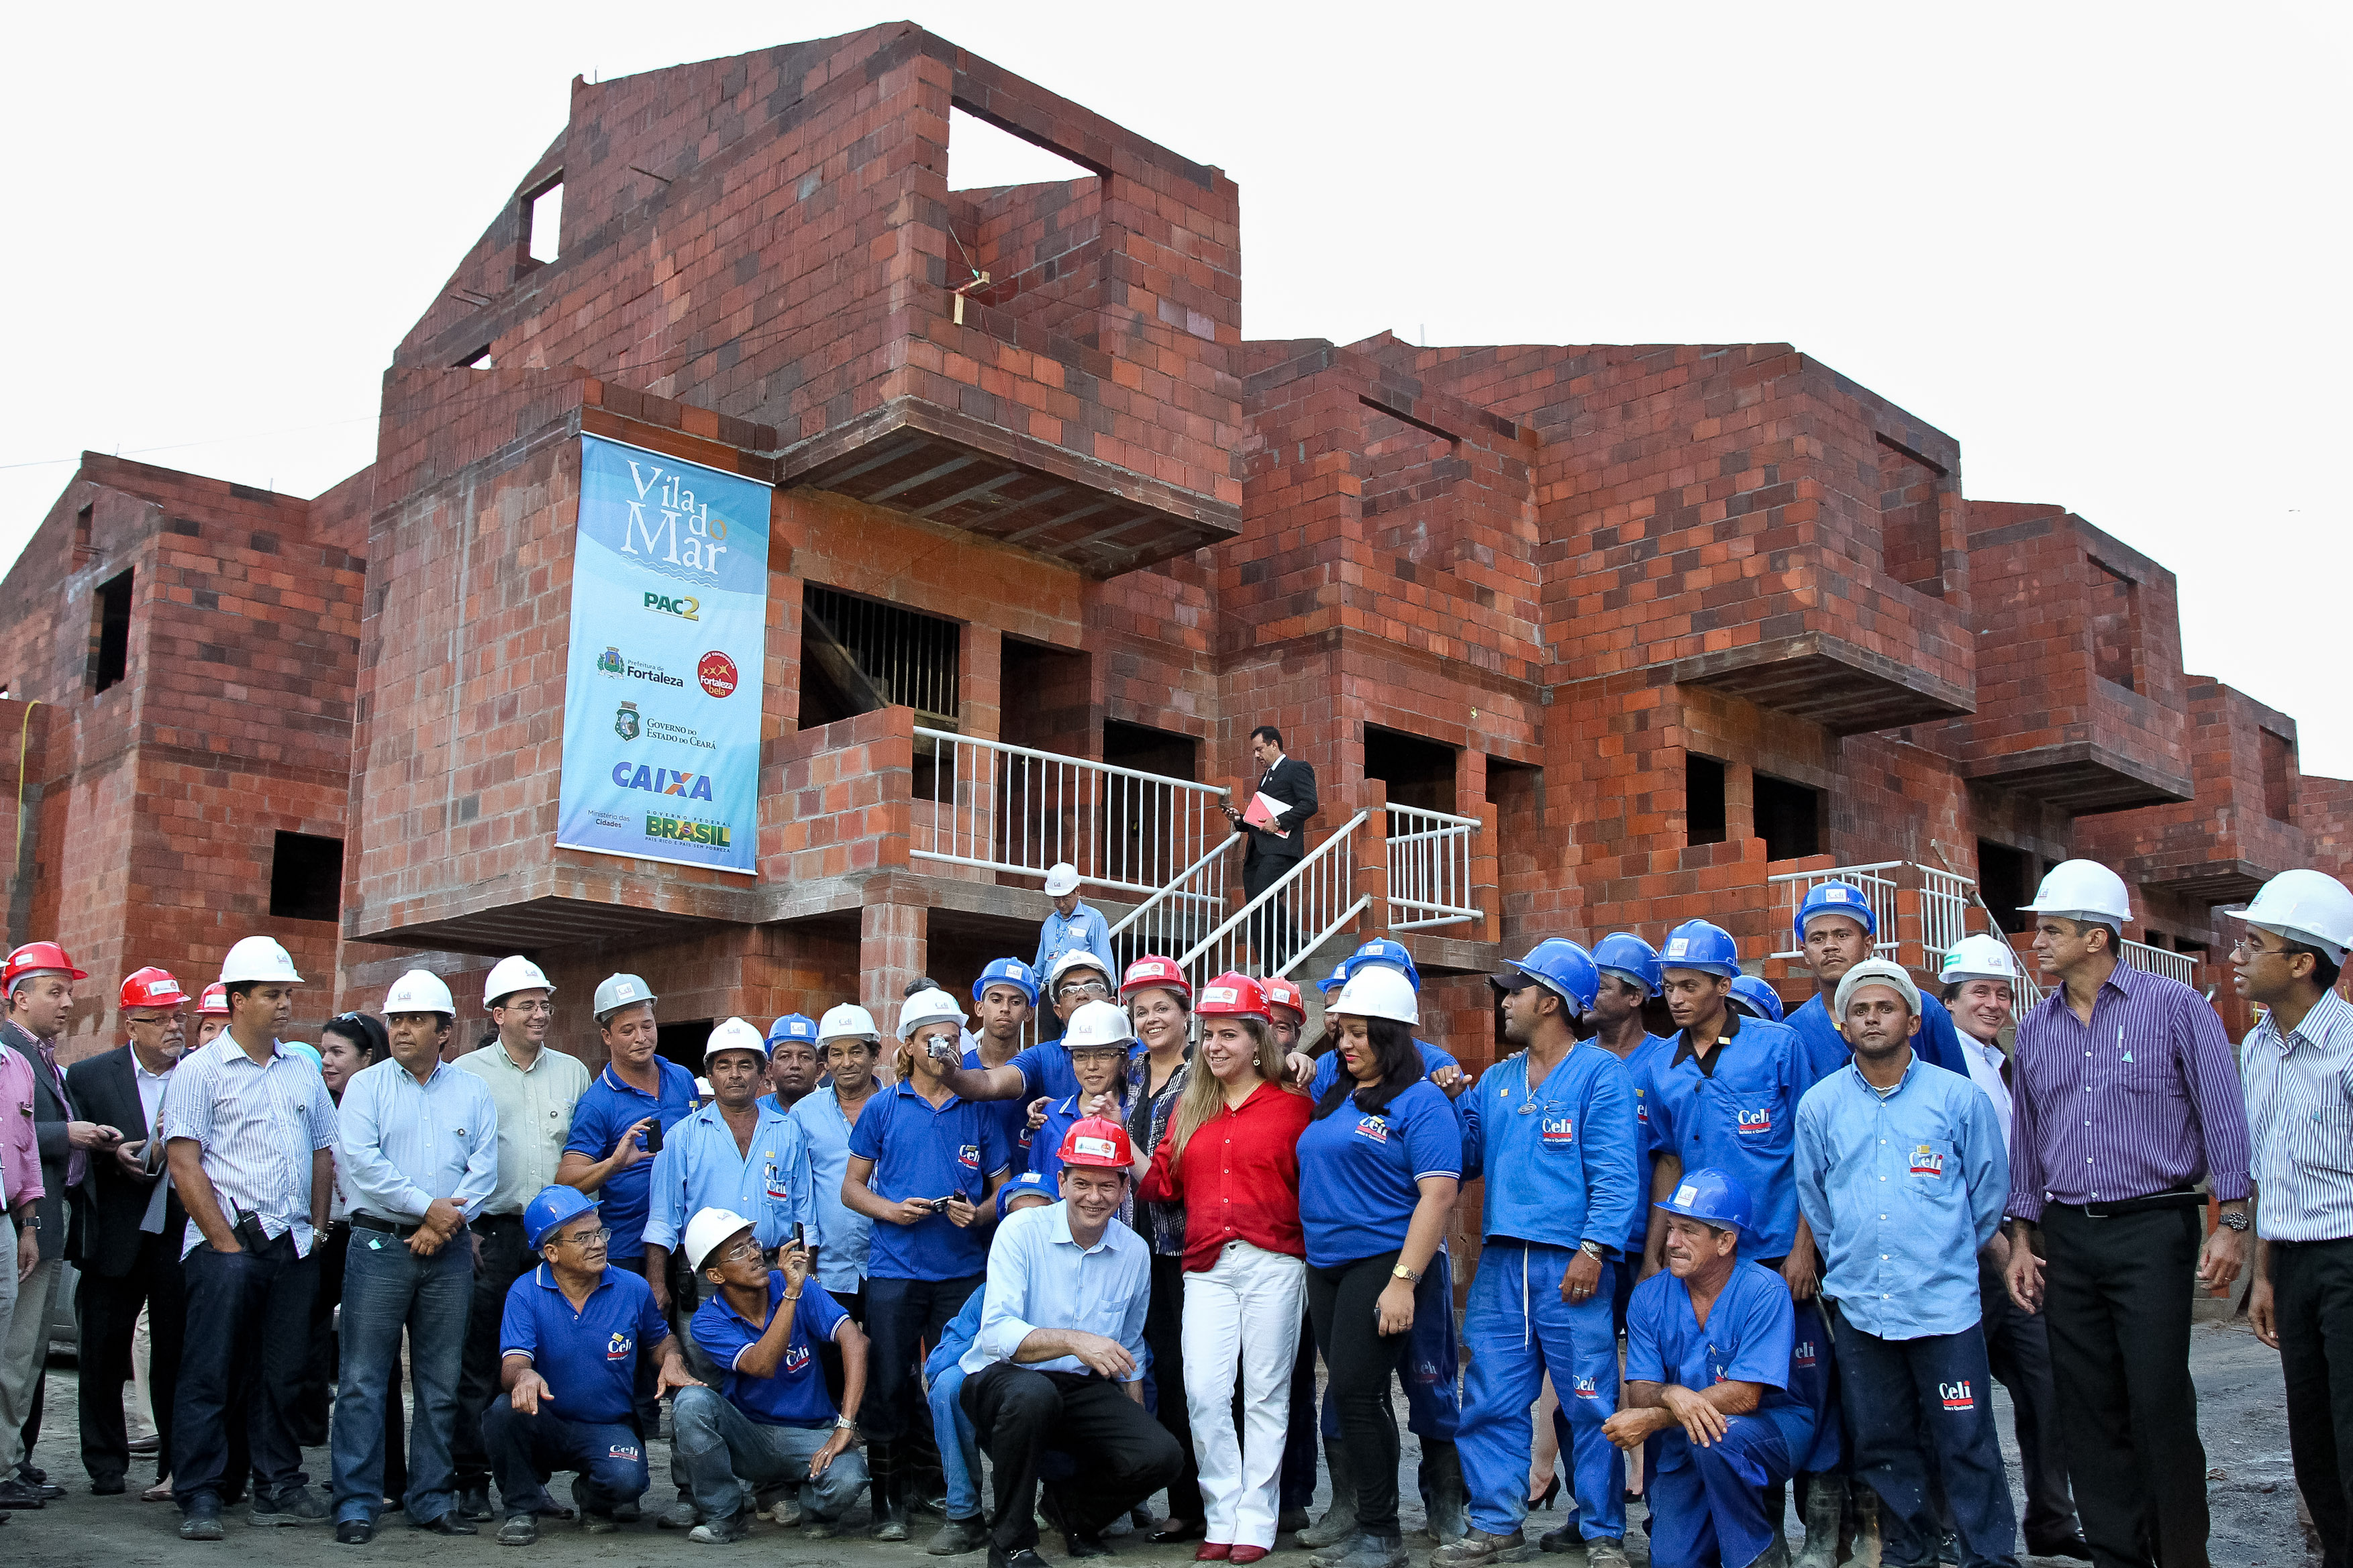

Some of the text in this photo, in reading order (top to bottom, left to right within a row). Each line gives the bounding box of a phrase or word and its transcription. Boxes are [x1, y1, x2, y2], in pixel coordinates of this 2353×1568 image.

[627, 460, 695, 513] Vila
[689, 503, 727, 540] do
[620, 500, 727, 574] Mar
[644, 591, 699, 621] PAC2
[628, 659, 656, 670] Prefeitura
[627, 666, 684, 688] Fortaleza
[700, 675, 734, 690] Fortaleza
[708, 684, 725, 696] bela
[646, 718, 687, 734] GOVERNO
[646, 728, 678, 742] ESTADO
[689, 736, 716, 749] CEARÁ
[611, 761, 713, 802] CAIXA
[587, 810, 617, 820] Ministério
[595, 819, 621, 828] Cidades
[646, 810, 731, 827] GOVERNO FEDERAL
[646, 815, 731, 848] BRASIL
[705, 845, 731, 853] POBREZA
[1738, 1108, 1770, 1125] Celi
[1542, 1118, 1572, 1133] Celi
[1909, 1151, 1944, 1170] Celi
[766, 1180, 787, 1194] Celi
[1679, 1188, 1693, 1198] Celi
[786, 1344, 809, 1367] Celi
[1795, 1341, 1815, 1358] eli
[1572, 1375, 1597, 1391] Celi
[1939, 1380, 1972, 1400] Celi
[609, 1445, 638, 1457] Celi
